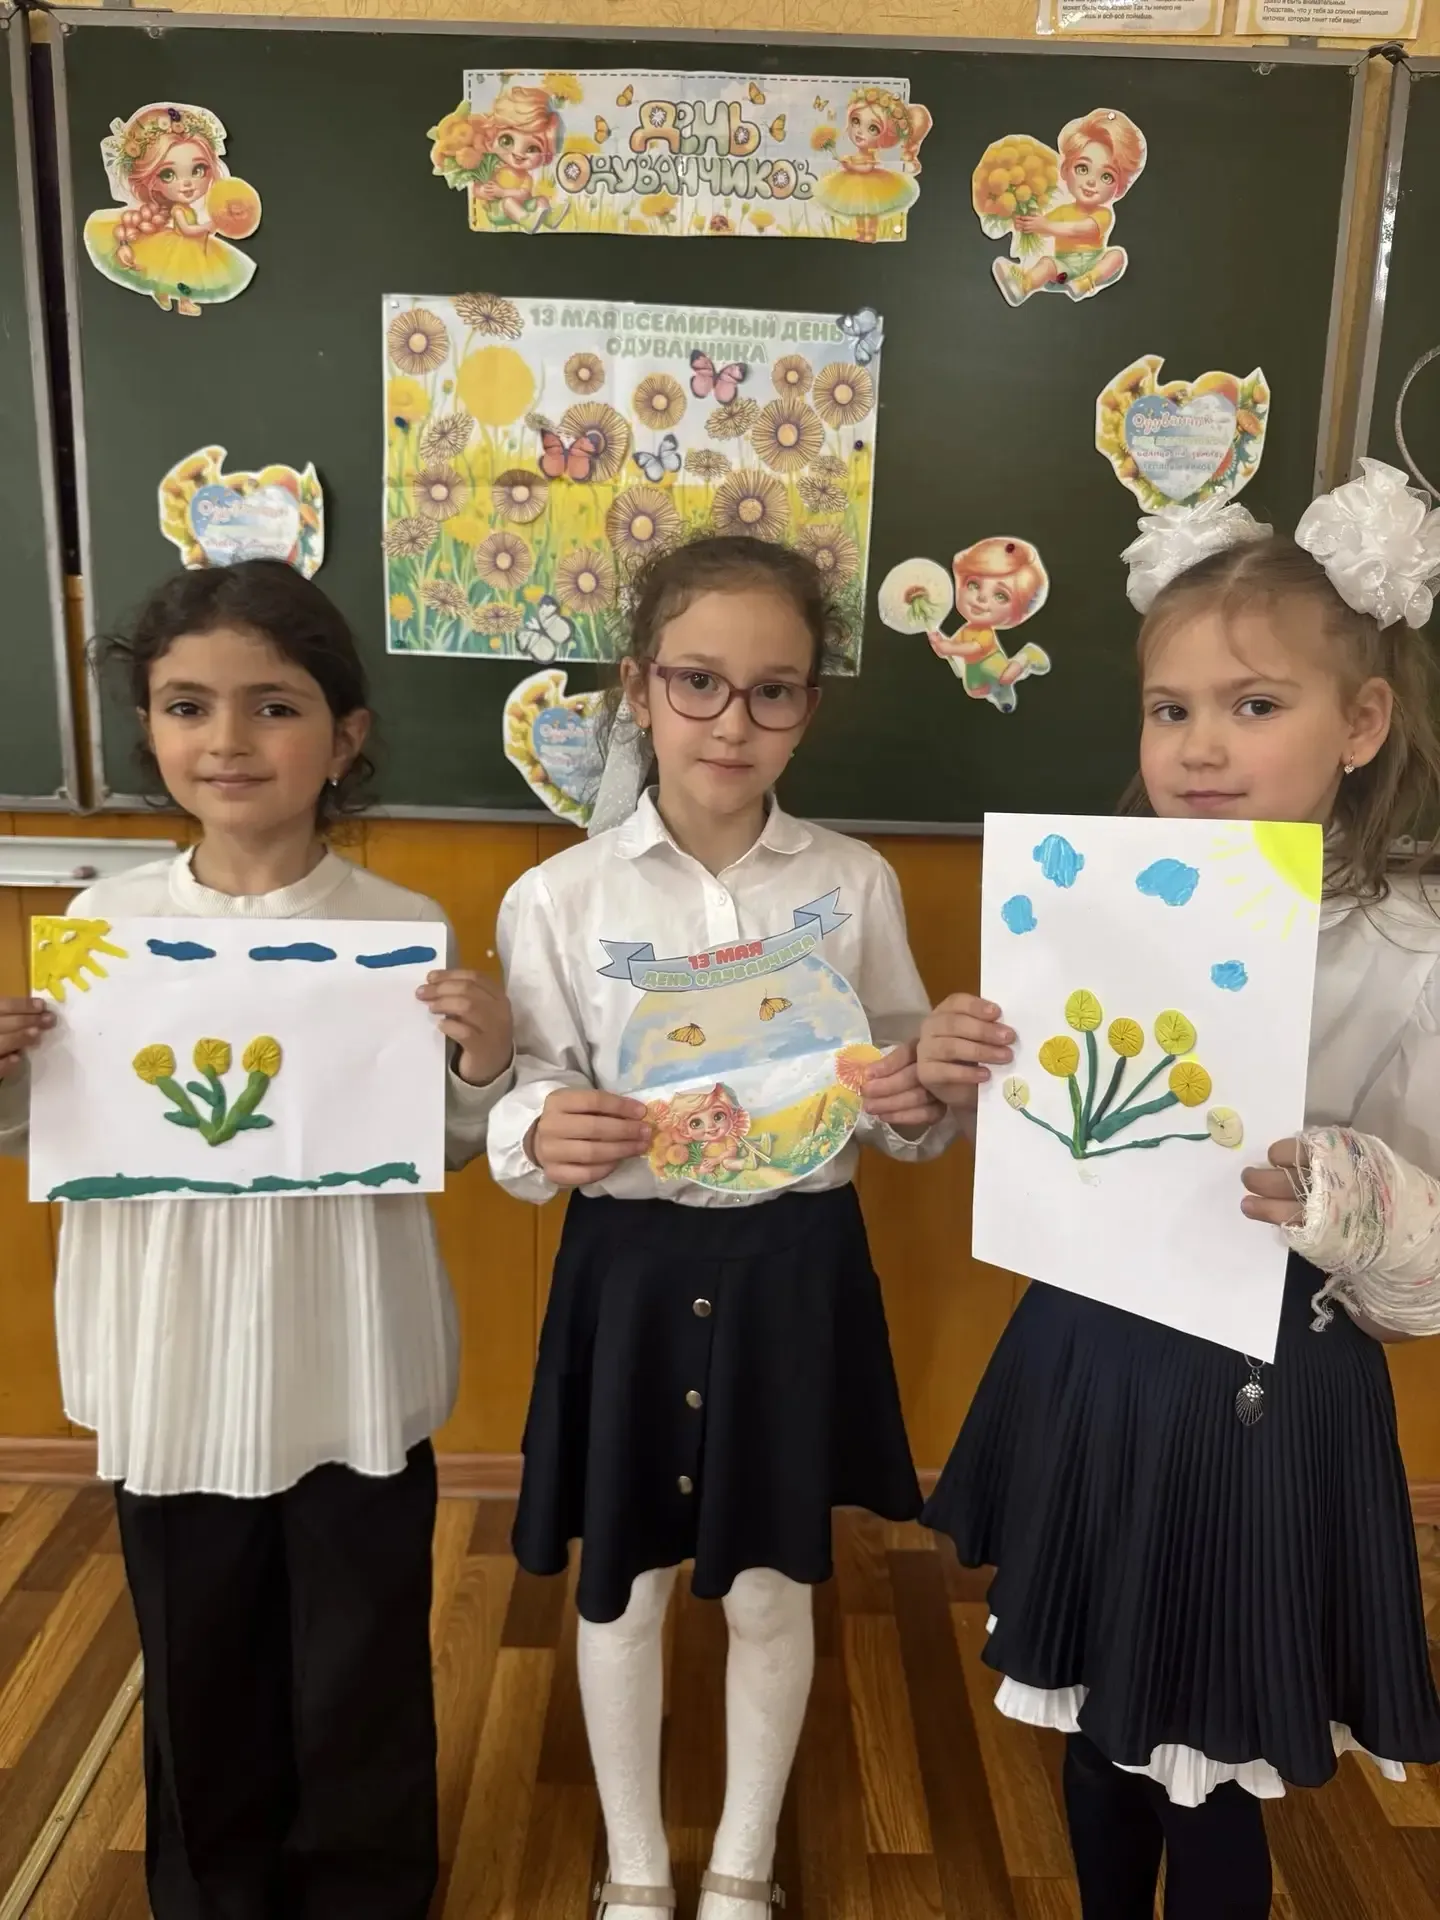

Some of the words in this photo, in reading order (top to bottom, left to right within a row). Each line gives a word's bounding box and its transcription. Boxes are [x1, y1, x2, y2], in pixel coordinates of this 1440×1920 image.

[630, 99, 761, 157] ДЕНЬ
[556, 152, 818, 200] ОДУВАНЧИКОВ
[529, 307, 556, 327] 13
[560, 308, 617, 331] МАЯ
[622, 311, 776, 341] ВСЕМИРНЫЙ
[780, 319, 845, 344] ДЕНЬ
[641, 971, 693, 989] ДЕНЬ
[695, 934, 817, 988] ОДУВАНЧИКА
[688, 952, 711, 971] 13
[715, 941, 764, 965] МАЯ
